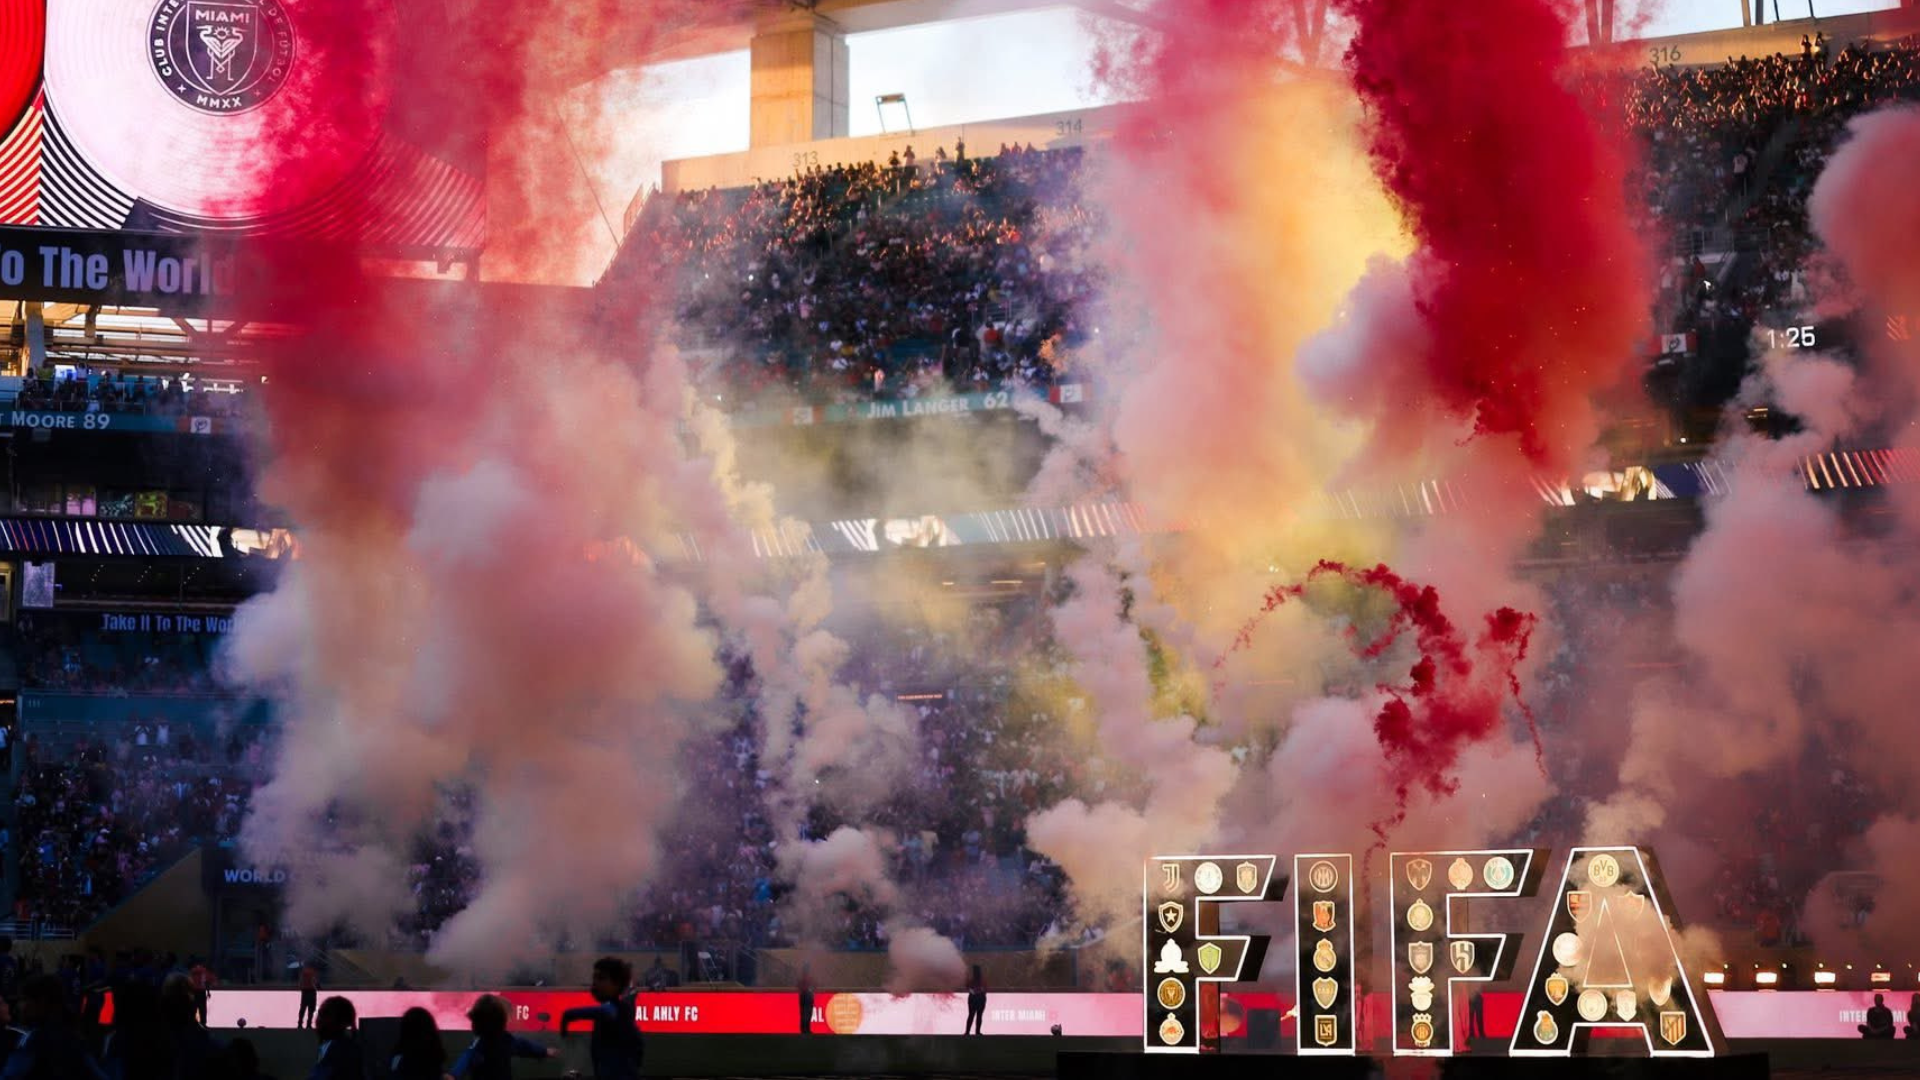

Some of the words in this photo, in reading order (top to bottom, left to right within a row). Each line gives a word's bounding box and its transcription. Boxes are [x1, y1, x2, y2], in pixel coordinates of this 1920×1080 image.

[195, 9, 249, 23] MIAMI
[154, 38, 172, 77] CLUB
[1649, 43, 1681, 62] 316
[196, 95, 242, 109] MMXX
[1056, 119, 1083, 135] 314
[792, 151, 819, 167] 313
[0, 243, 25, 287] o
[39, 246, 109, 291] The
[124, 249, 236, 297] World
[1767, 326, 1816, 349] 1:25
[902, 397, 969, 417] LANGER
[983, 392, 1008, 410] 62
[11, 411, 76, 428] MOORE
[83, 413, 110, 430] 89
[101, 613, 136, 631] Take
[155, 614, 171, 632] To
[175, 615, 201, 632] The
[206, 616, 246, 634] Worl
[224, 869, 286, 883] WORLD
[1593, 859, 1615, 877] BVB
[1144, 846, 1714, 1057] FIFA
[516, 1005, 530, 1021] FC
[635, 1006, 649, 1022] AL
[653, 1006, 680, 1022] AHLY
[684, 1006, 699, 1022] FC
[810, 1007, 825, 1022] AL
